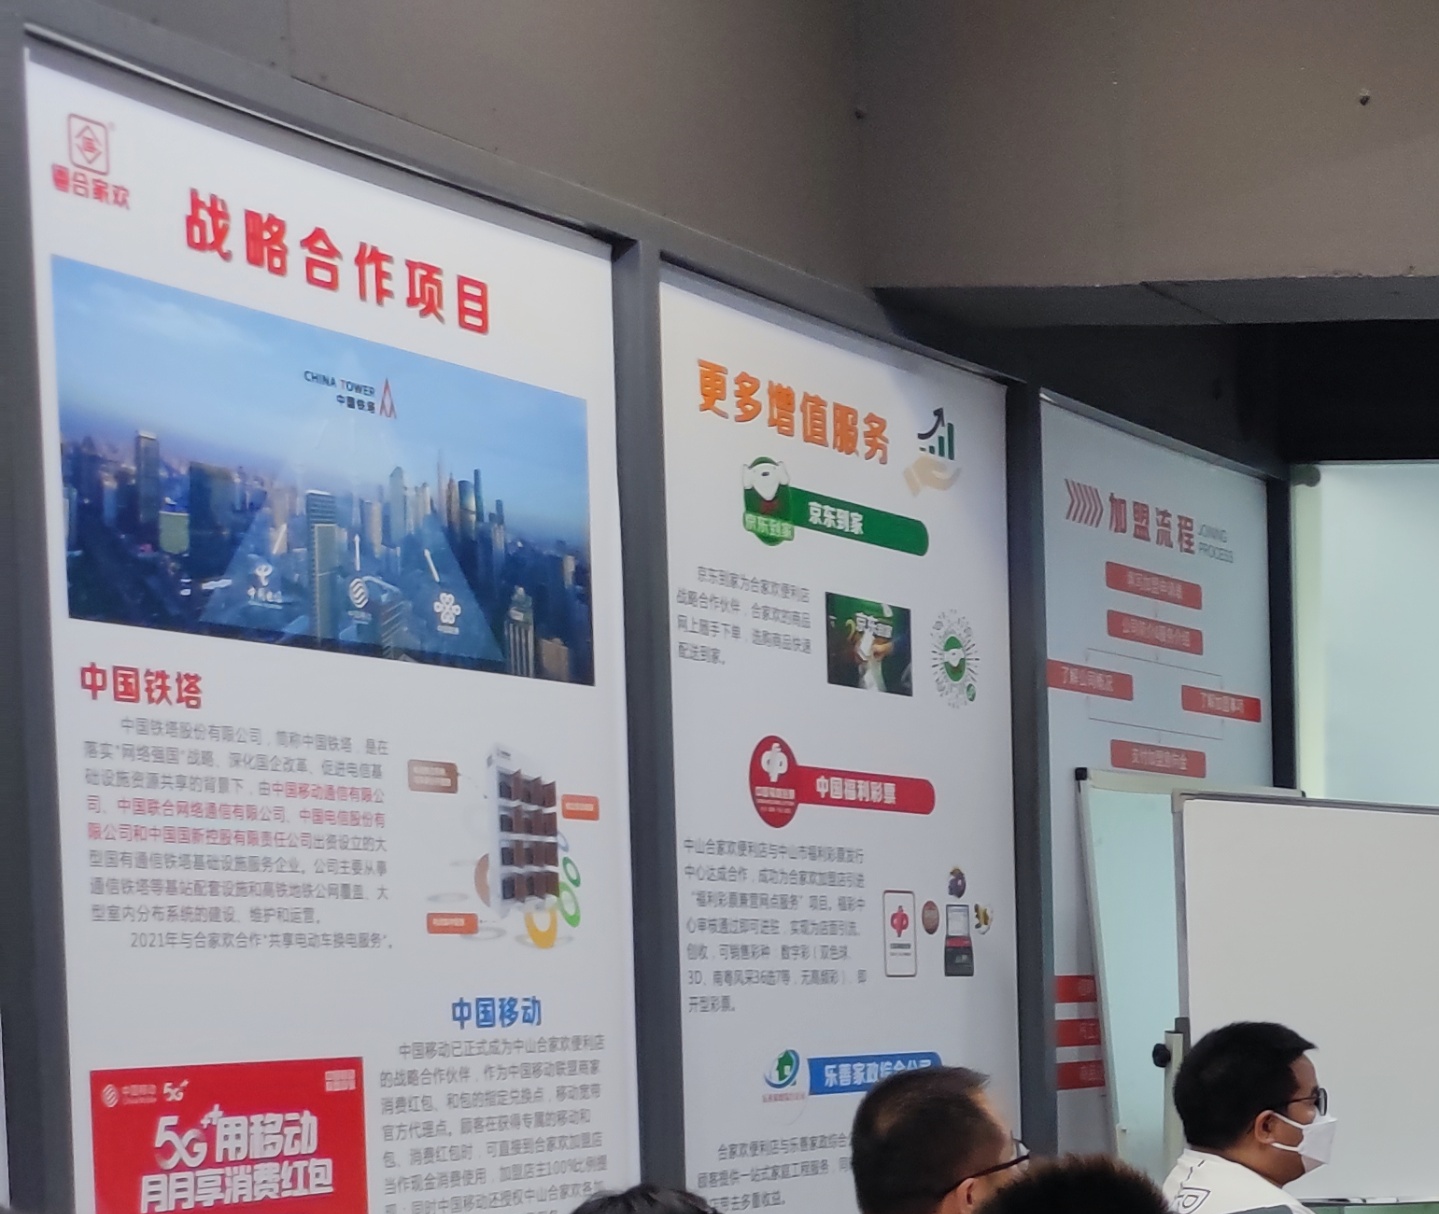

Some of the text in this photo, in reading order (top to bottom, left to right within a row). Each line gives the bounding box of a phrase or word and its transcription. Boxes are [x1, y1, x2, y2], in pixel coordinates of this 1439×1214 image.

[185, 188, 489, 334] 战略合作项目
[303, 370, 375, 397] CHINA TOWER
[698, 358, 890, 465] 更多增值服务
[808, 501, 864, 534] 京东到家
[1109, 492, 1195, 554] 加盟流程
[80, 662, 202, 709] 中国铁塔
[815, 775, 896, 805] 中国福利彩票
[452, 996, 542, 1029] 中国移动
[140, 1158, 334, 1214] 月月享消费红包
